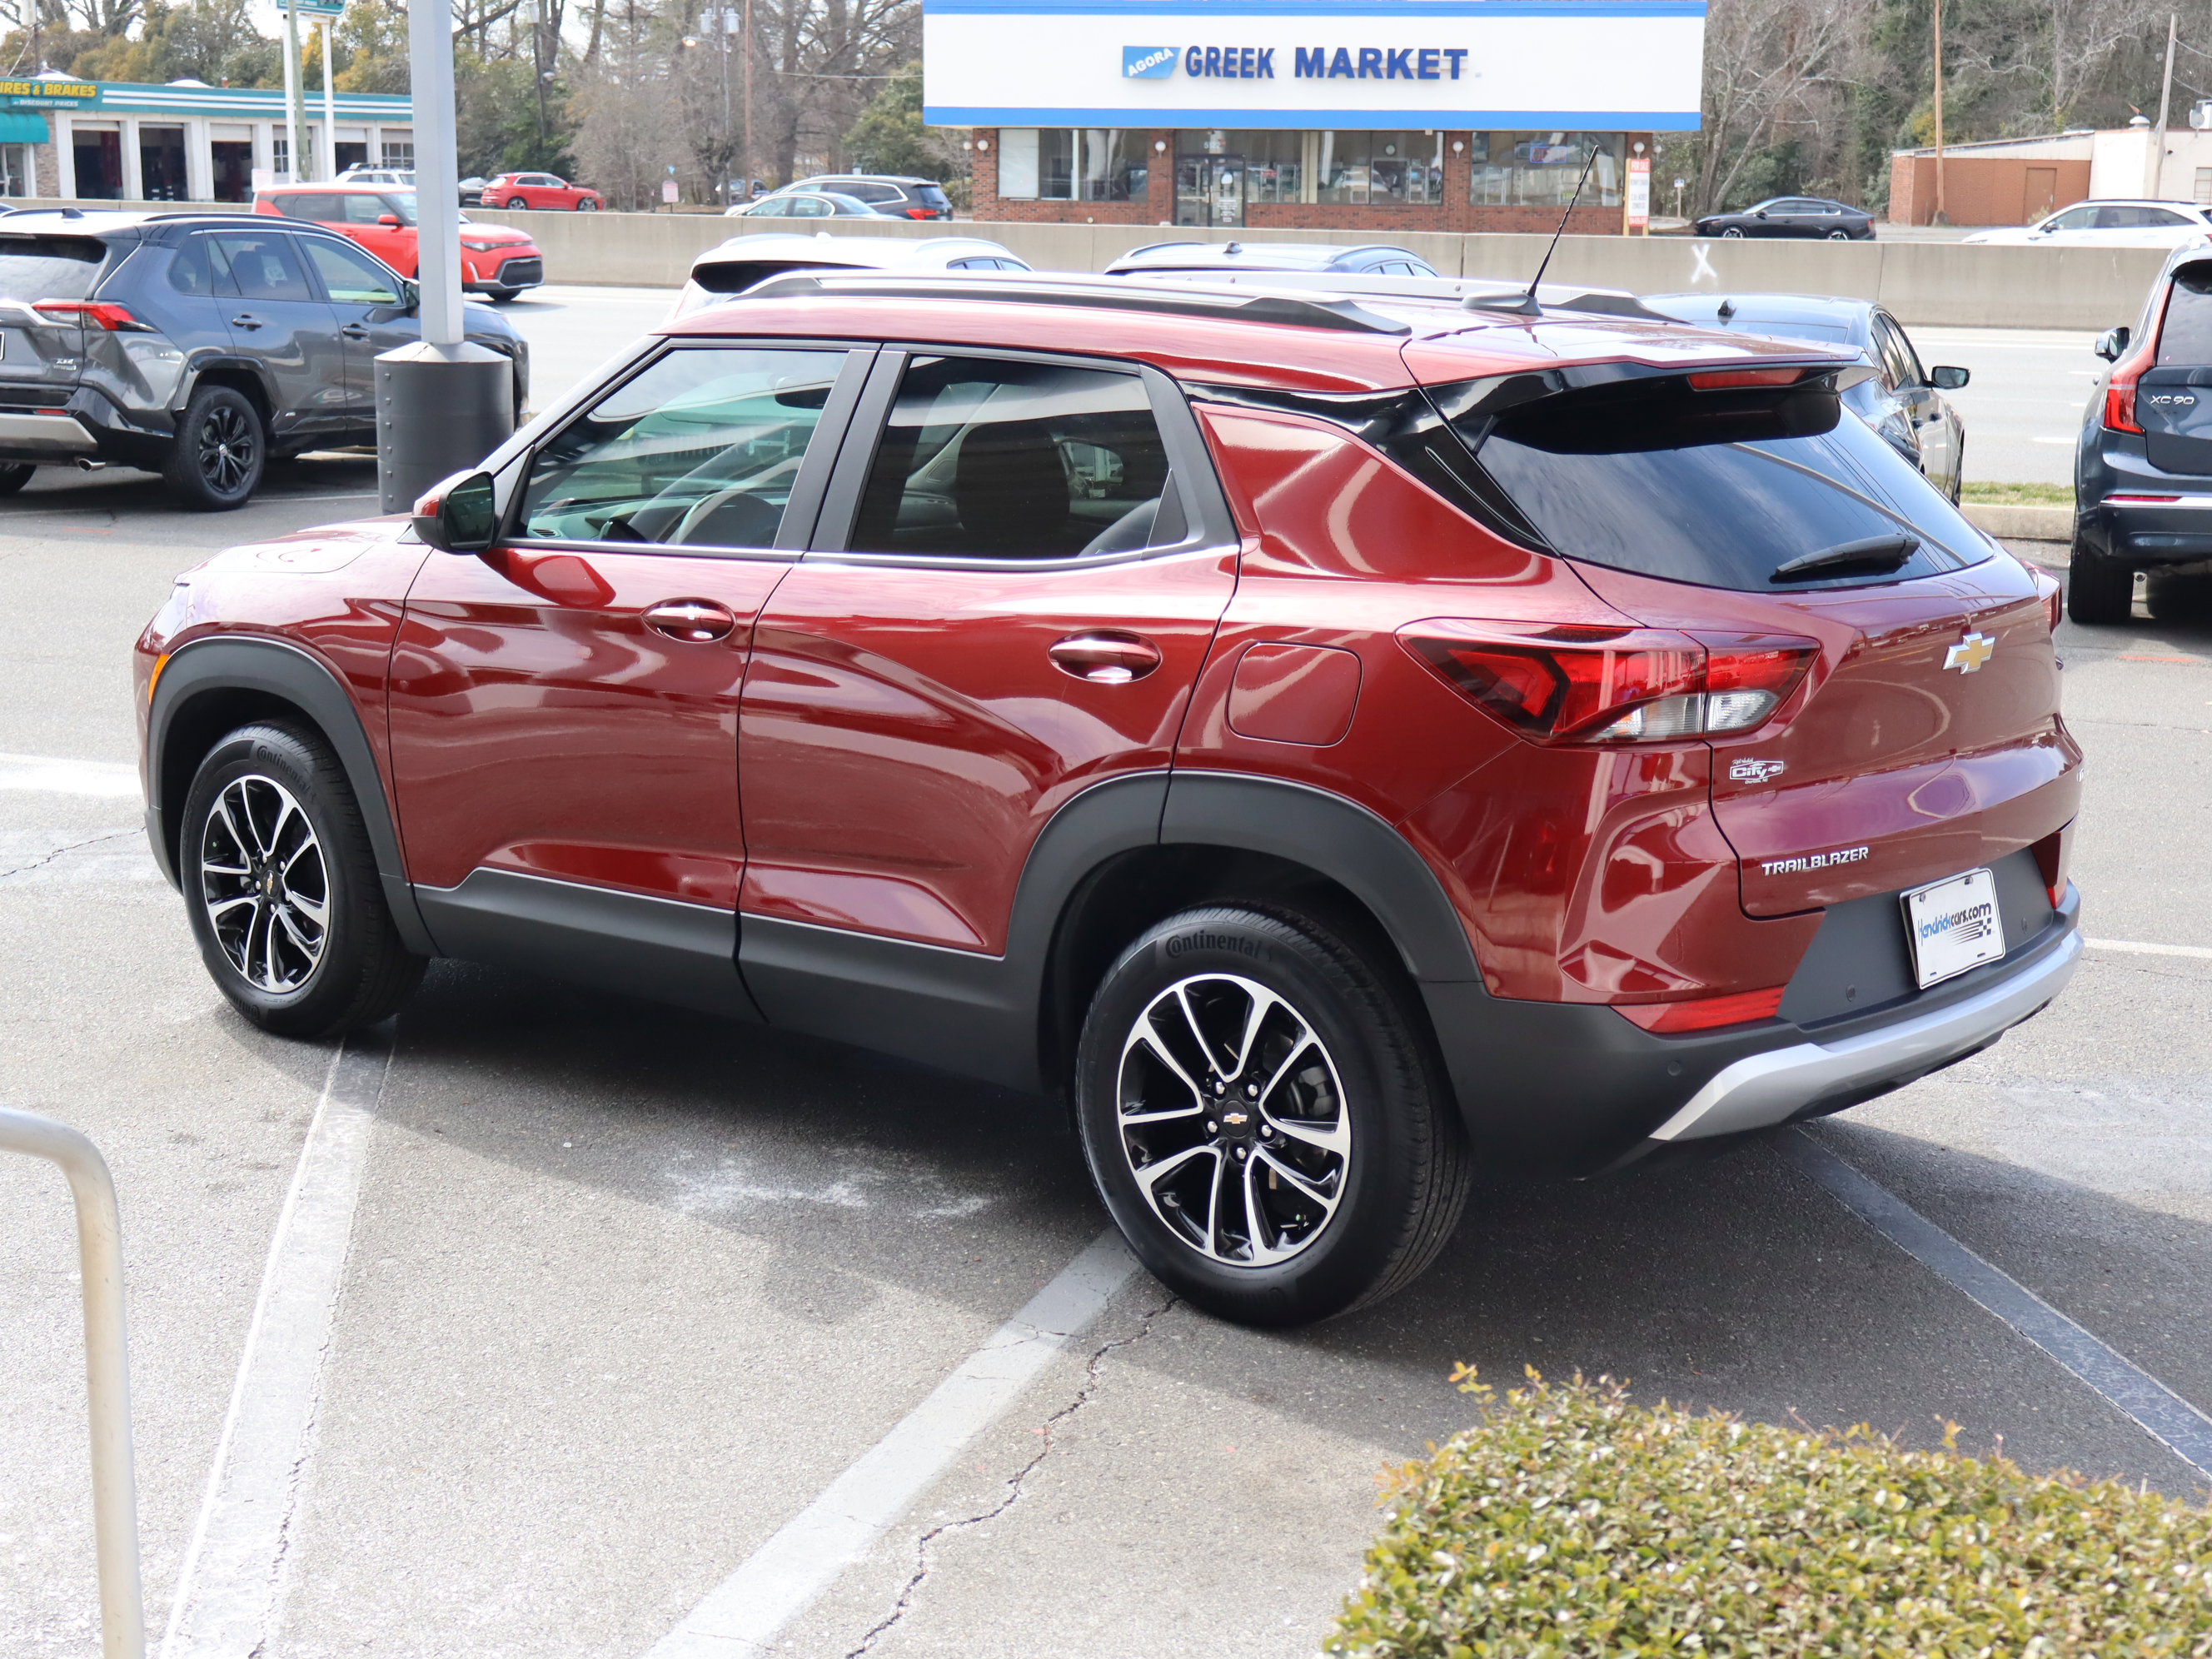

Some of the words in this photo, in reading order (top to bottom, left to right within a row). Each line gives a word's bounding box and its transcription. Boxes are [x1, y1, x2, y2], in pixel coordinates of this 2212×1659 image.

[1128, 47, 1174, 77] AGORA
[1185, 45, 1275, 79] GREEK
[1294, 47, 1468, 80] MARKET
[32, 84, 41, 95] &
[44, 83, 97, 97] BRAKES
[257, 745, 311, 794] Continental
[1731, 766, 1767, 778] City
[1761, 846, 1869, 876] TRAILBLAZER
[1165, 929, 1263, 959] Continental
